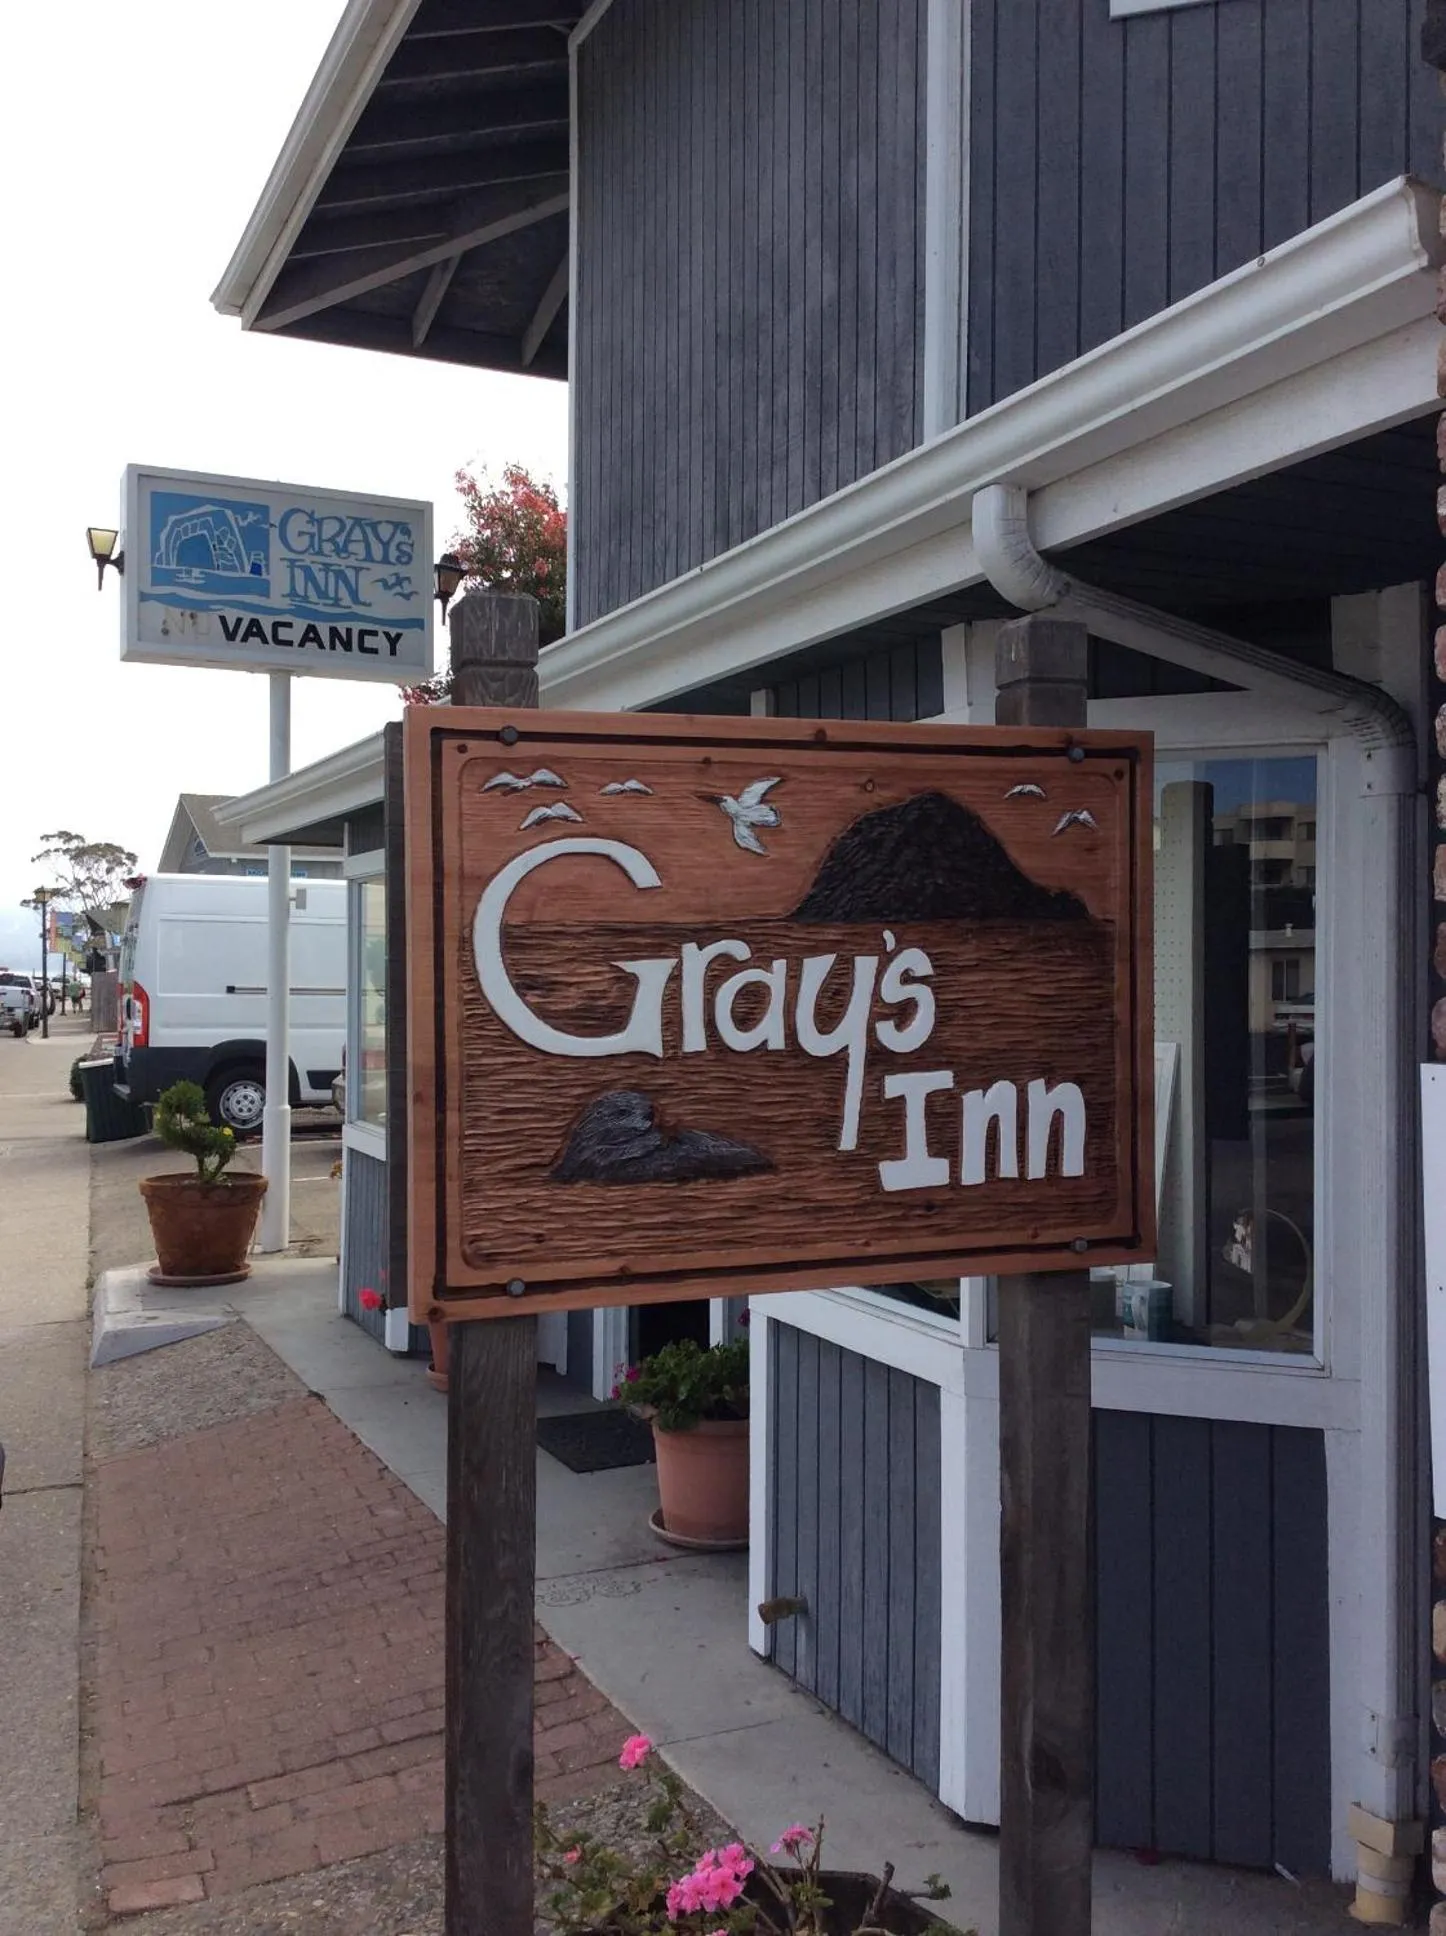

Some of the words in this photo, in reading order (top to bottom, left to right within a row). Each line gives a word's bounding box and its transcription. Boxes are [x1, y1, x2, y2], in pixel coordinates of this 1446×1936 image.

[280, 556, 372, 609] INN
[218, 614, 403, 657] VACANCY
[473, 837, 936, 1152] Gray's
[878, 1070, 1087, 1192] Inn
